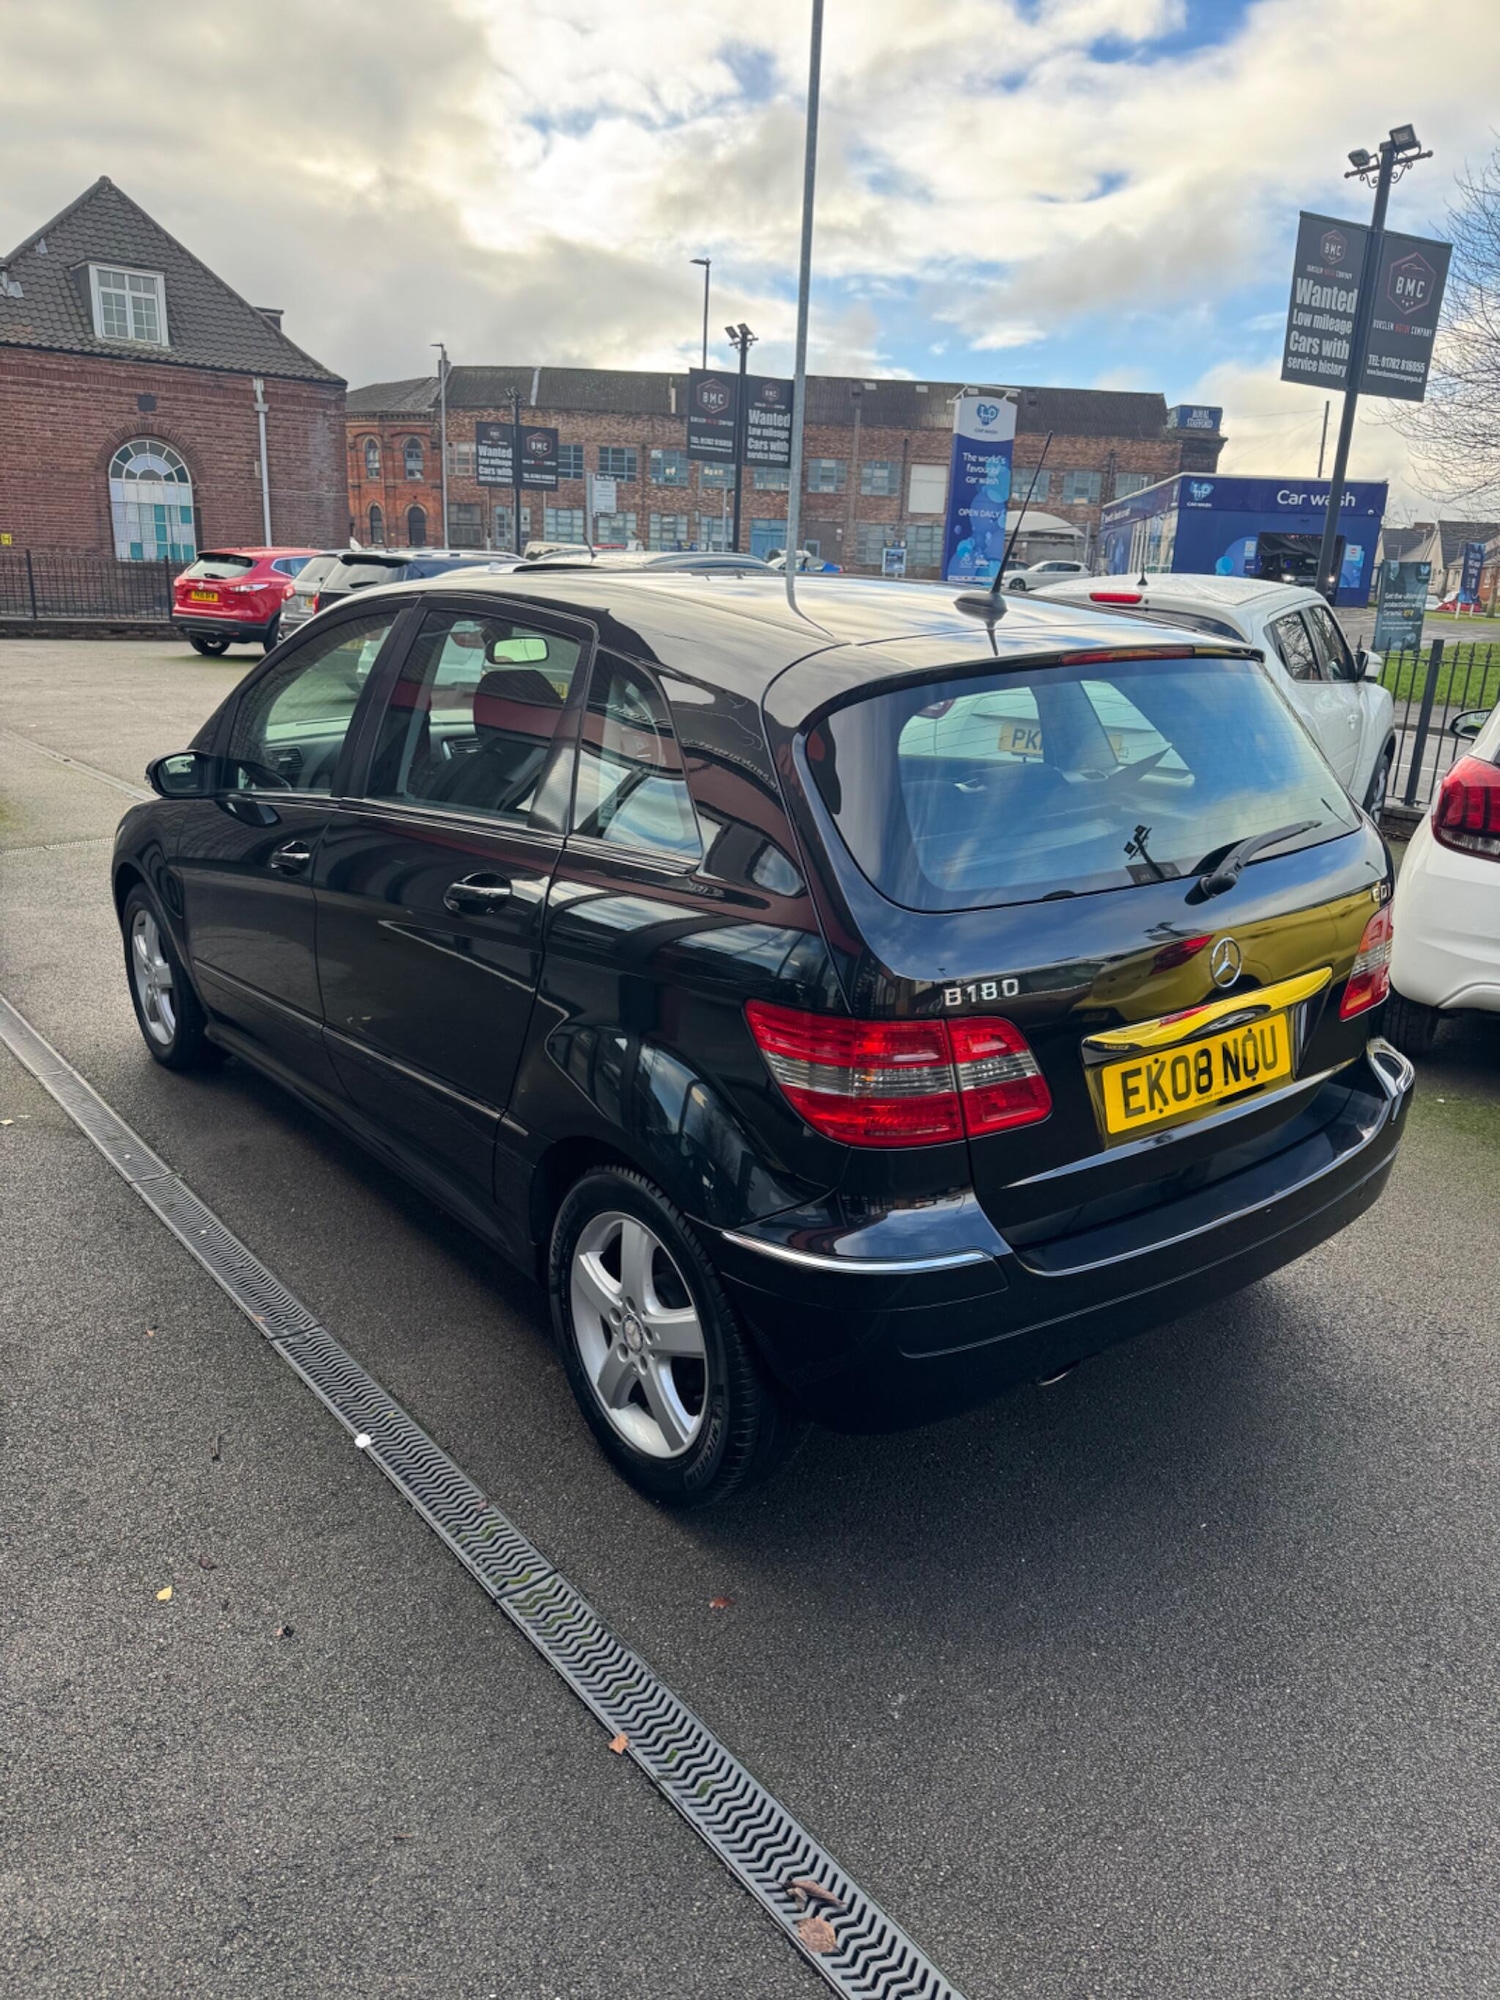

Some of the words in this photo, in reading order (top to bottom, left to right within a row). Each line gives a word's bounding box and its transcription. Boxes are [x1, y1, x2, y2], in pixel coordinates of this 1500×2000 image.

[1324, 243, 1342, 256] BMC
[1396, 276, 1425, 298] BMC
[1296, 277, 1359, 314] Wanted
[1292, 308, 1312, 328] Low
[1313, 314, 1353, 335] mileage
[1289, 330, 1320, 355] Cars
[1321, 337, 1350, 360] with
[1287, 356, 1318, 373] service
[1318, 359, 1347, 378] history
[703, 392, 724, 404] BMC
[748, 409, 791, 428] Wanted
[748, 426, 761, 436] Low
[762, 427, 789, 439] mileage
[478, 445, 512, 458] Wanted
[747, 437, 768, 451] Cars
[769, 440, 789, 452] with
[769, 453, 789, 462] history
[963, 452, 976, 462] The
[979, 455, 1006, 464] world's
[979, 477, 999, 485] wash
[1276, 490, 1307, 505] Car
[958, 508, 979, 517] OPEN
[980, 509, 1000, 518] DAILY
[944, 979, 1019, 1007] B180
[1121, 1048, 1213, 1119] EK08
[1221, 1025, 1278, 1087] NOU
